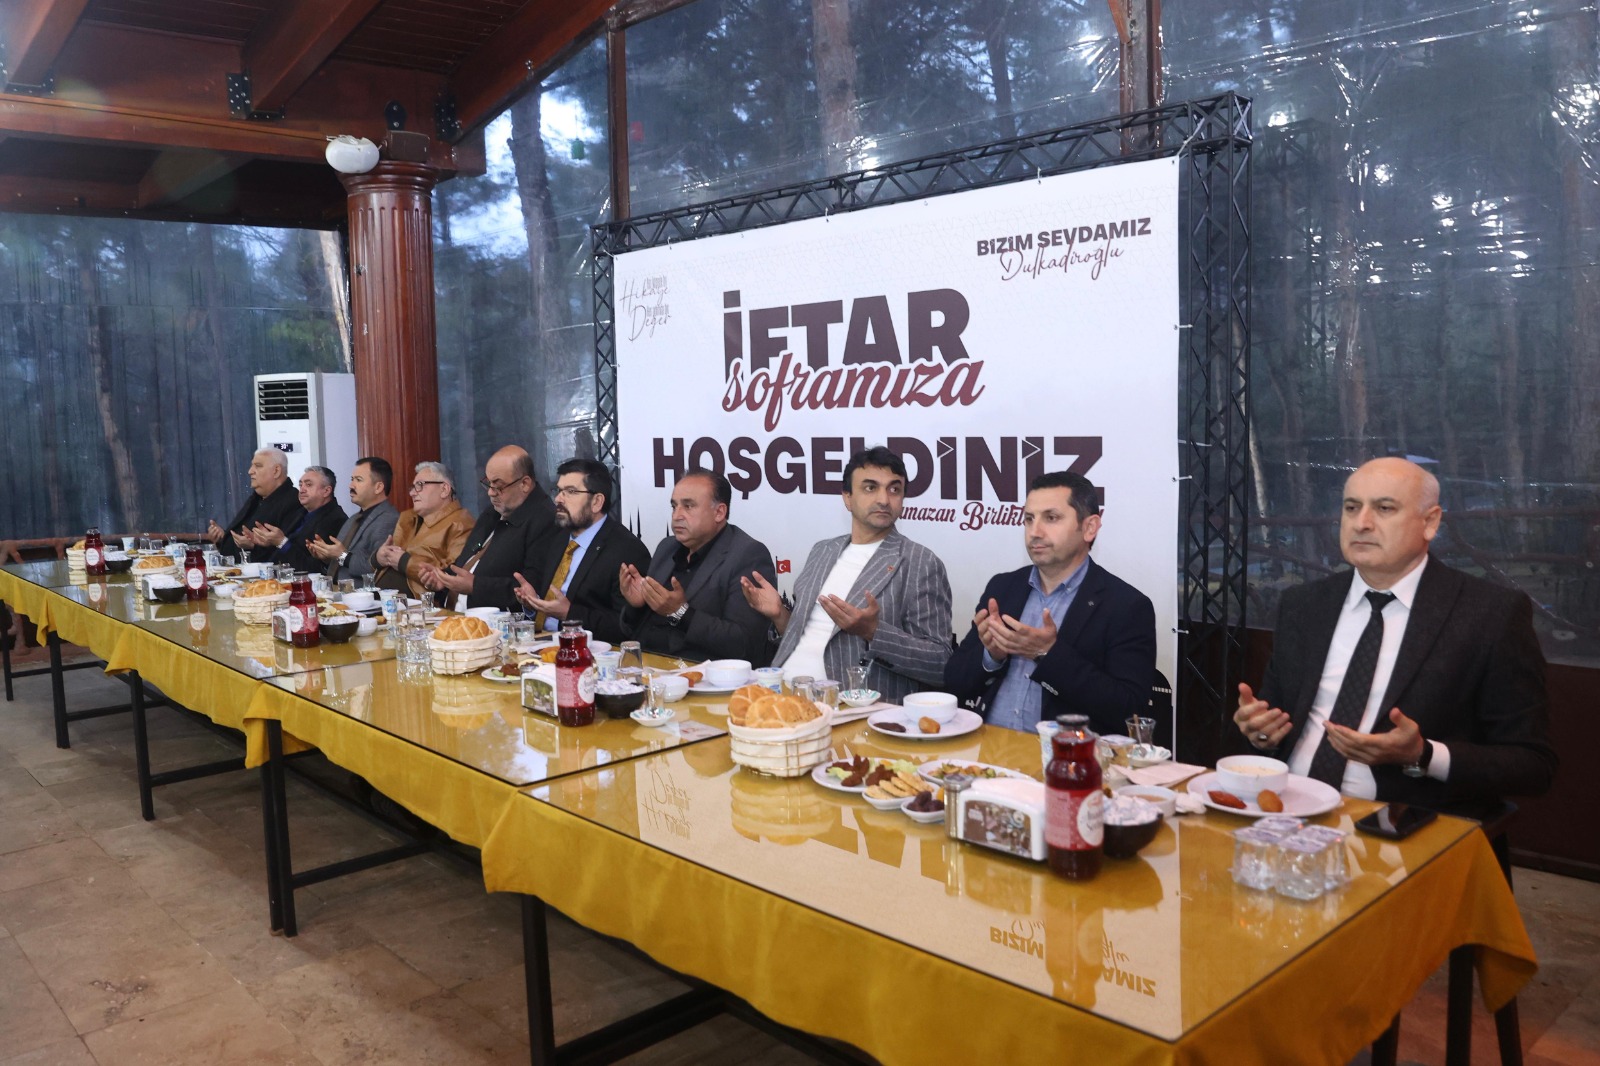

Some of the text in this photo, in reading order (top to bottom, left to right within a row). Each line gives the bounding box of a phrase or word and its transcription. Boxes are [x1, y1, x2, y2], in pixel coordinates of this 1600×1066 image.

[1037, 217, 1152, 249] SEVDAMIZ
[723, 288, 970, 384] İFTAR
[722, 352, 986, 432] soframıza
[652, 435, 1105, 506] HOŞGEDİNİZ
[900, 501, 1026, 531] mazan Birlikt
